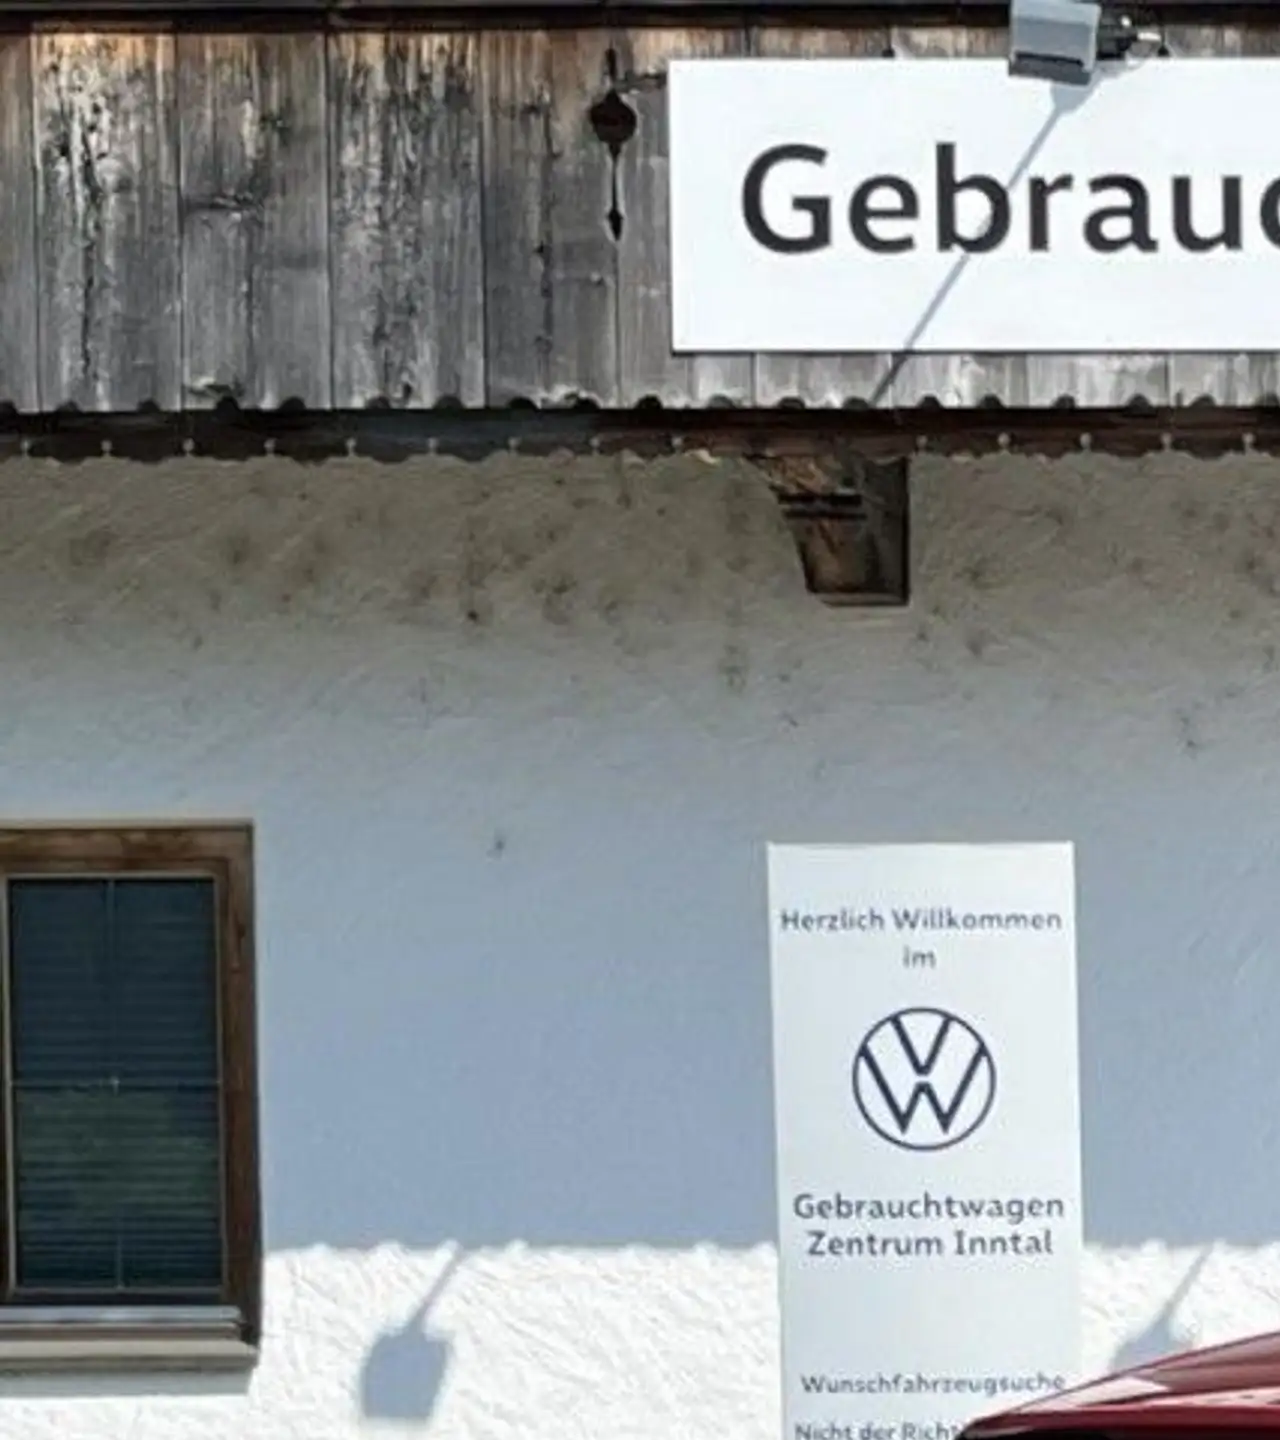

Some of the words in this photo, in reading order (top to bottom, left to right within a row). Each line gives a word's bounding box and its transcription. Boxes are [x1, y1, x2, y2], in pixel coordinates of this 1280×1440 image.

[781, 908, 885, 931] Herzlich
[892, 907, 1062, 931] Willkommen
[903, 947, 936, 969] im
[793, 1193, 1064, 1225] Gebrauchtwagen
[807, 1230, 942, 1257] Zentrum
[953, 1230, 1054, 1256] Inntal
[800, 1373, 1067, 1397] Wunschfahrzeugsuche
[860, 1422, 894, 1440] der
